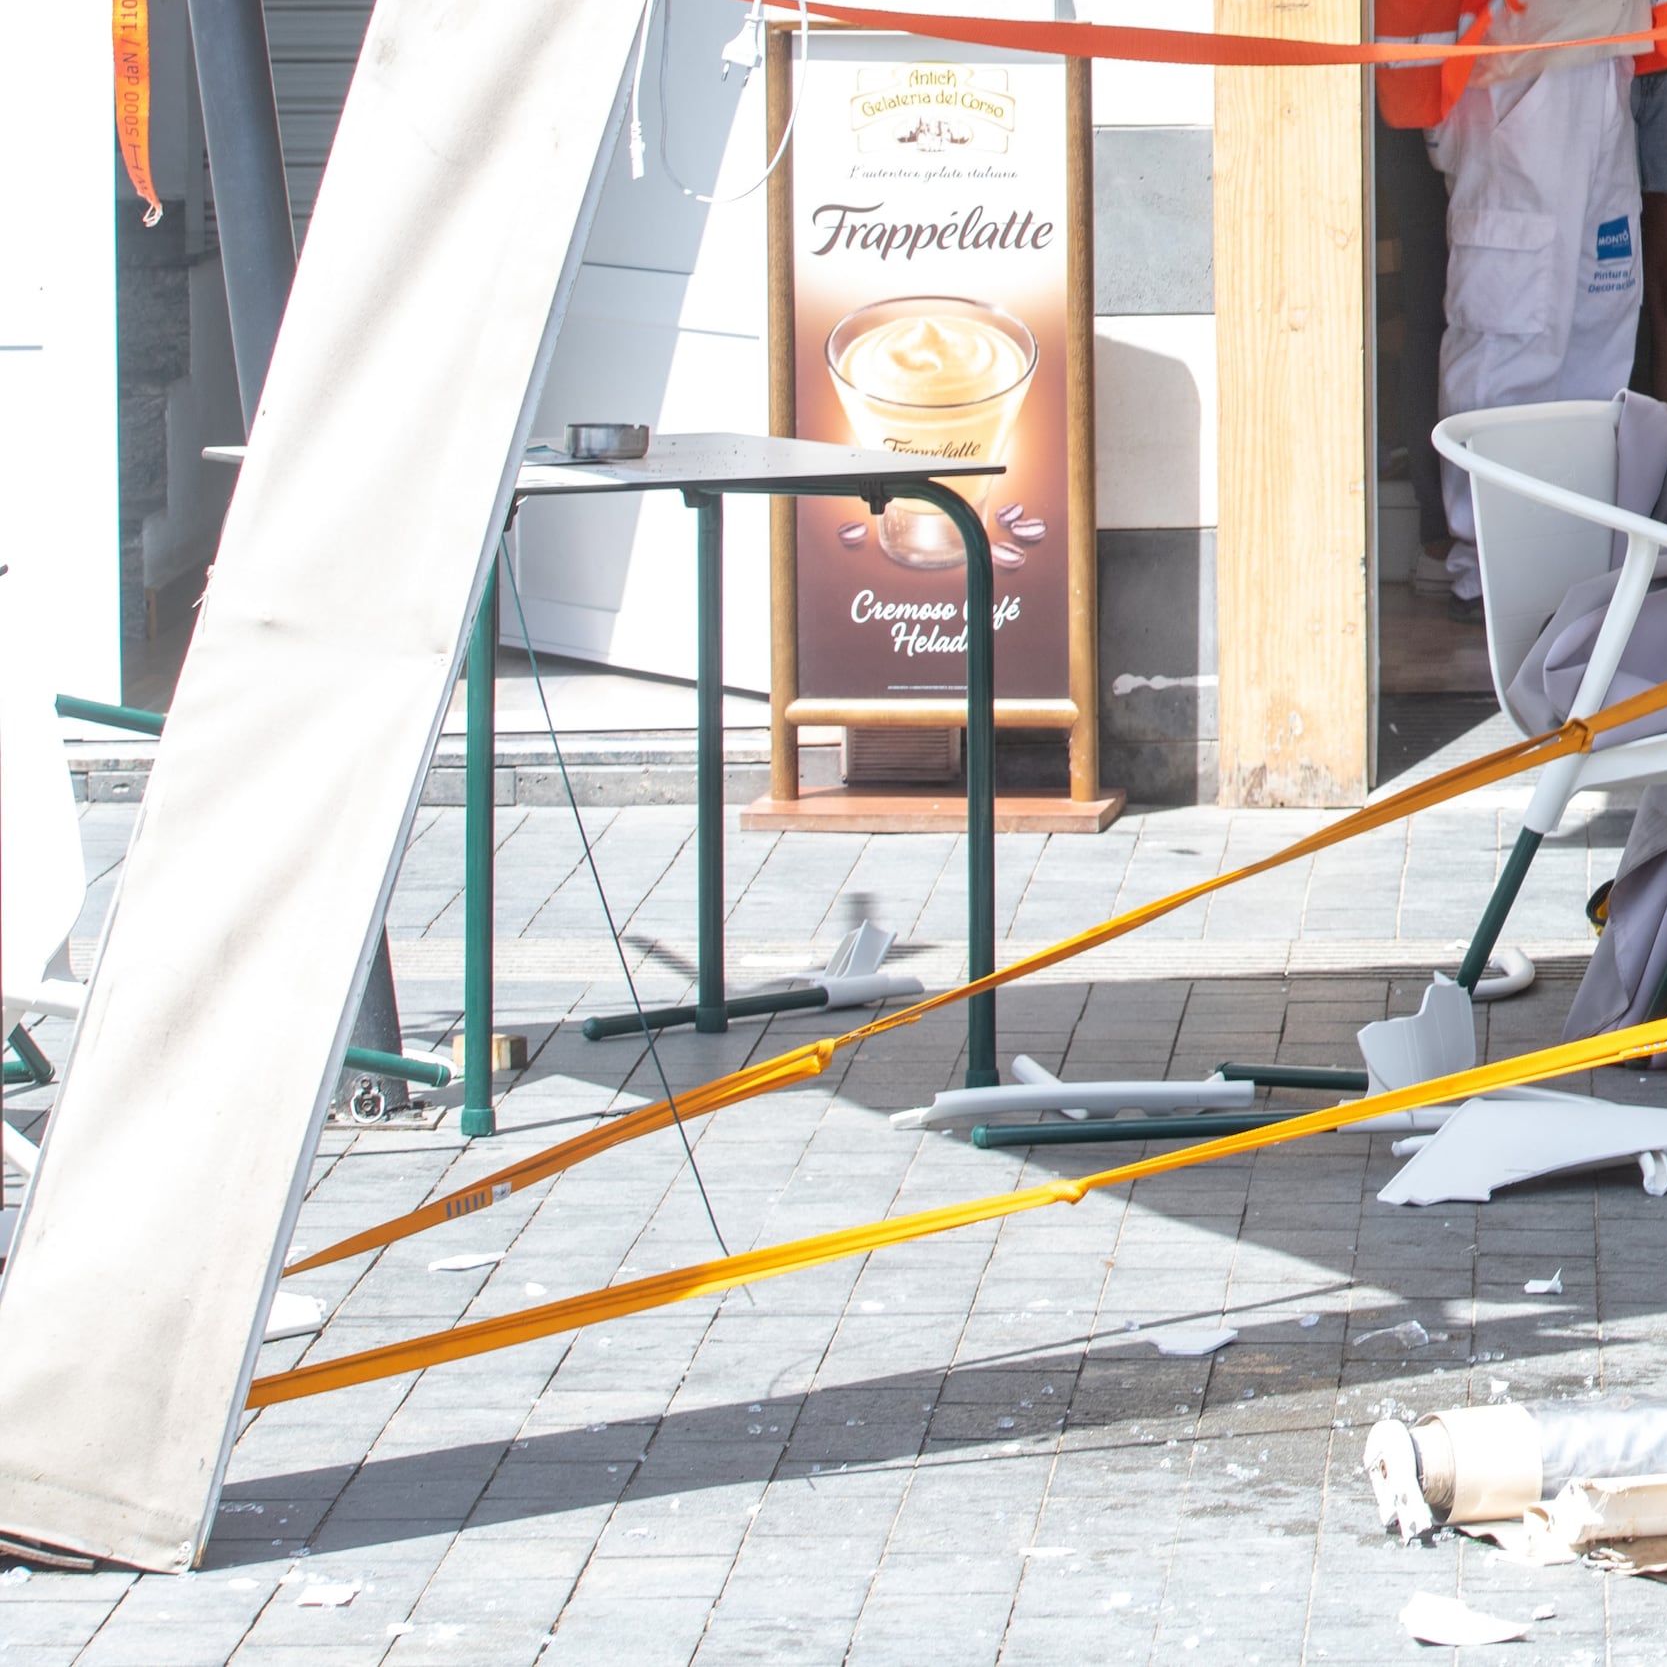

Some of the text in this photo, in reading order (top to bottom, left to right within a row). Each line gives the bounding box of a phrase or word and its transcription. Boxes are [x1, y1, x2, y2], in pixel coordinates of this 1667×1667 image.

[123, 48, 140, 85] daN
[124, 89, 140, 138] 5000
[861, 90, 1005, 119] Gelateria del Corso
[809, 200, 1054, 262] Frappélatte
[850, 589, 1022, 631] Cremoso fé
[890, 621, 969, 658] Helad
